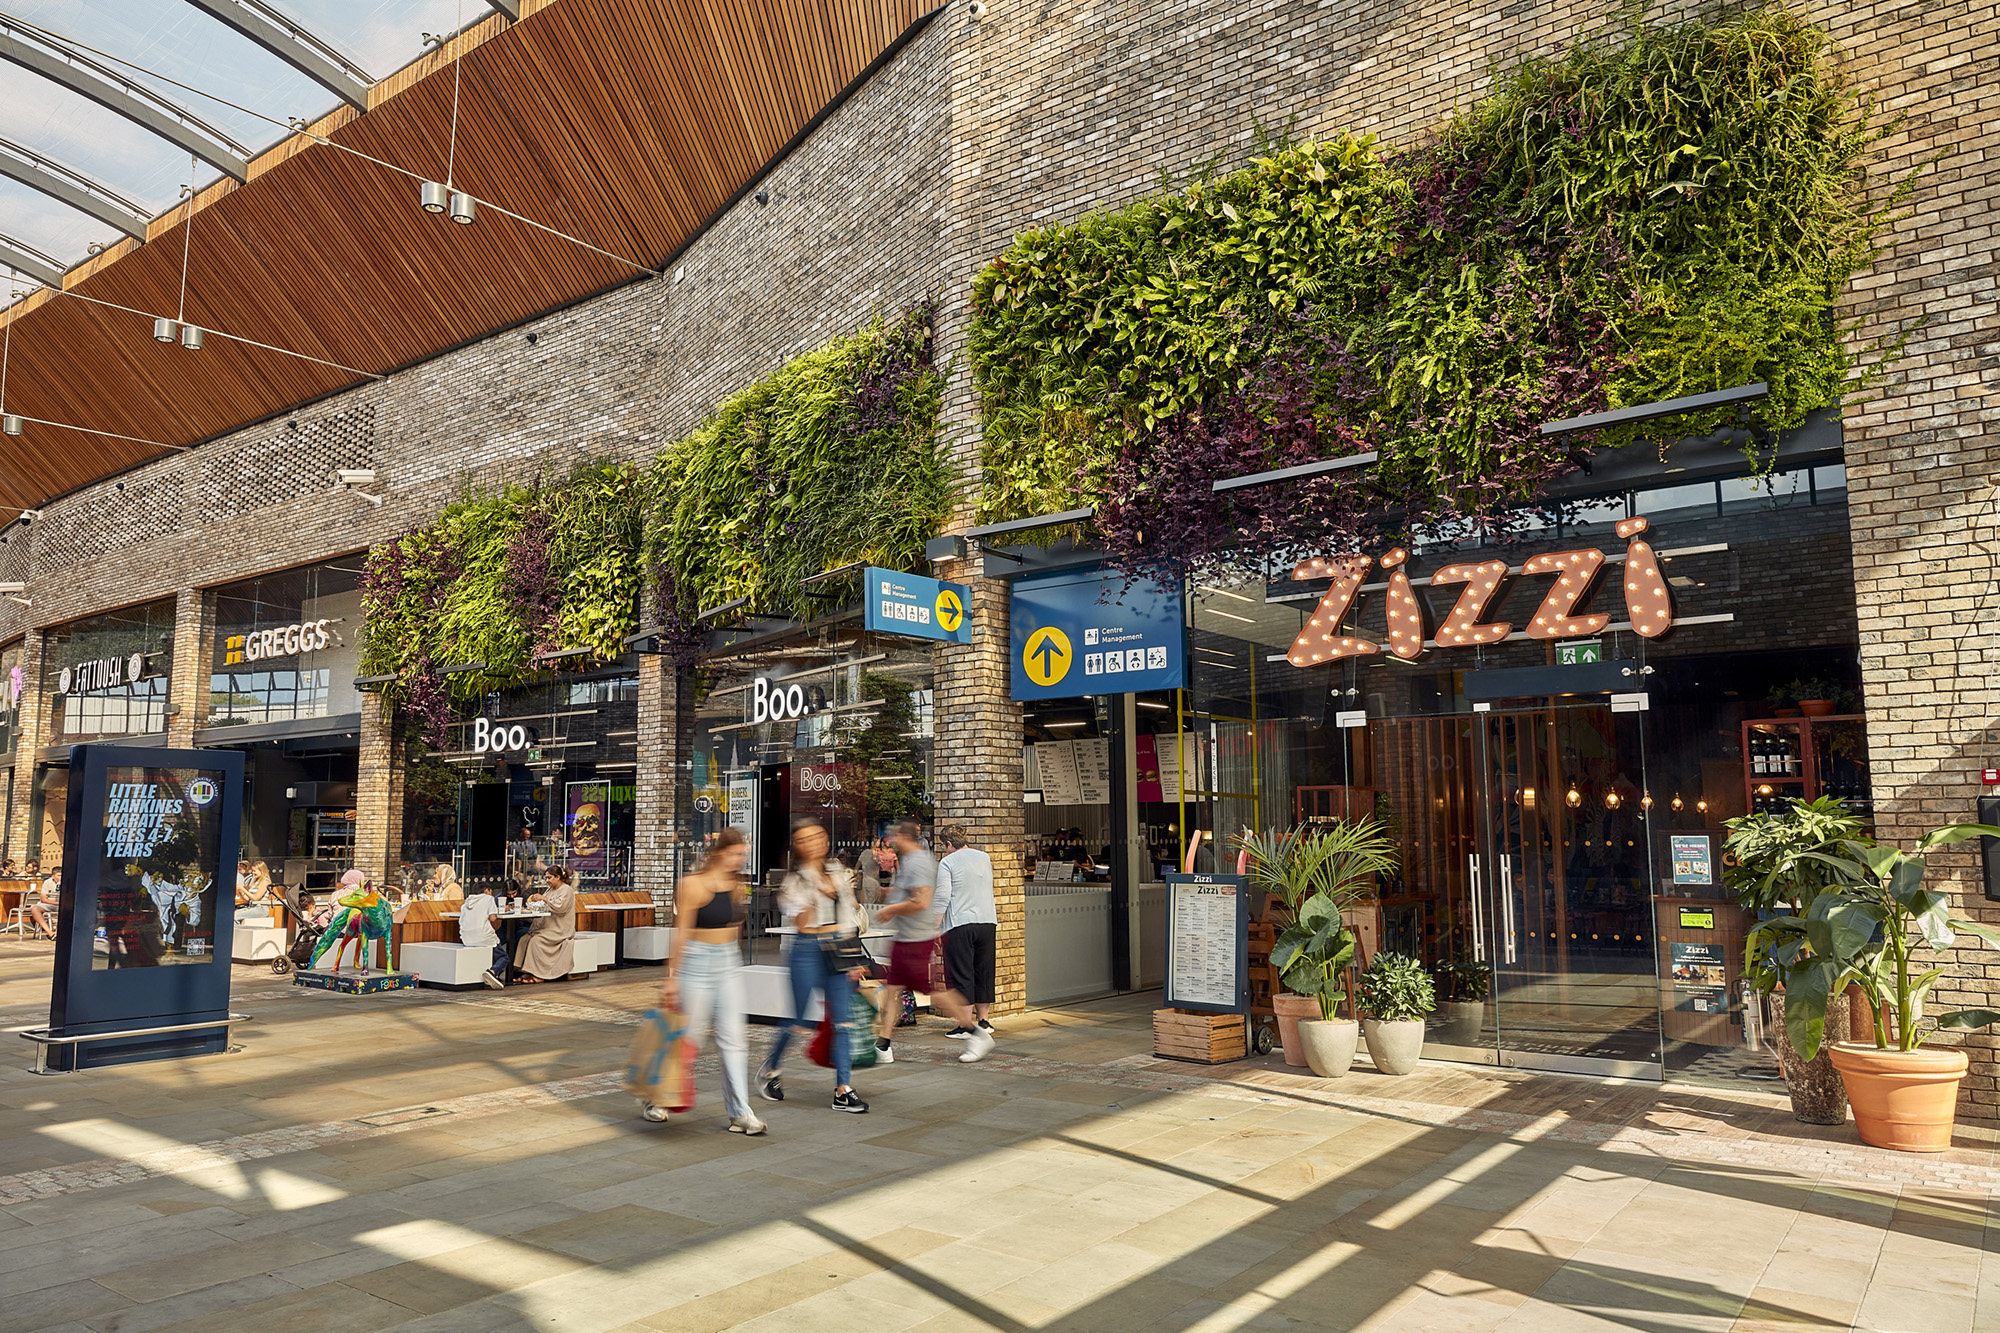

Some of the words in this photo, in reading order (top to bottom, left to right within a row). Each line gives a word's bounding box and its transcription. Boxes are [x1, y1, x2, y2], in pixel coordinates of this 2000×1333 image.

[891, 583, 906, 591] Centre
[1286, 516, 1672, 668] Zizzi
[891, 590, 917, 600] Management
[1101, 627, 1124, 635] Centre
[1101, 633, 1143, 644] Management
[245, 619, 329, 662] GREGGS
[754, 677, 809, 724] Boo.
[474, 717, 531, 753] Boo.
[800, 767, 842, 792] Boo.
[109, 783, 158, 799] LITTLE
[107, 798, 184, 815] RANKINES
[106, 813, 166, 828] KARATE
[104, 827, 147, 843] AGES
[146, 827, 174, 843] 4-7
[106, 842, 155, 858] YEARS
[1193, 875, 1213, 883] Zizzi
[1197, 886, 1219, 895] Zizzi
[1685, 945, 1710, 955] Zizzi
[380, 978, 400, 990] FOXES
